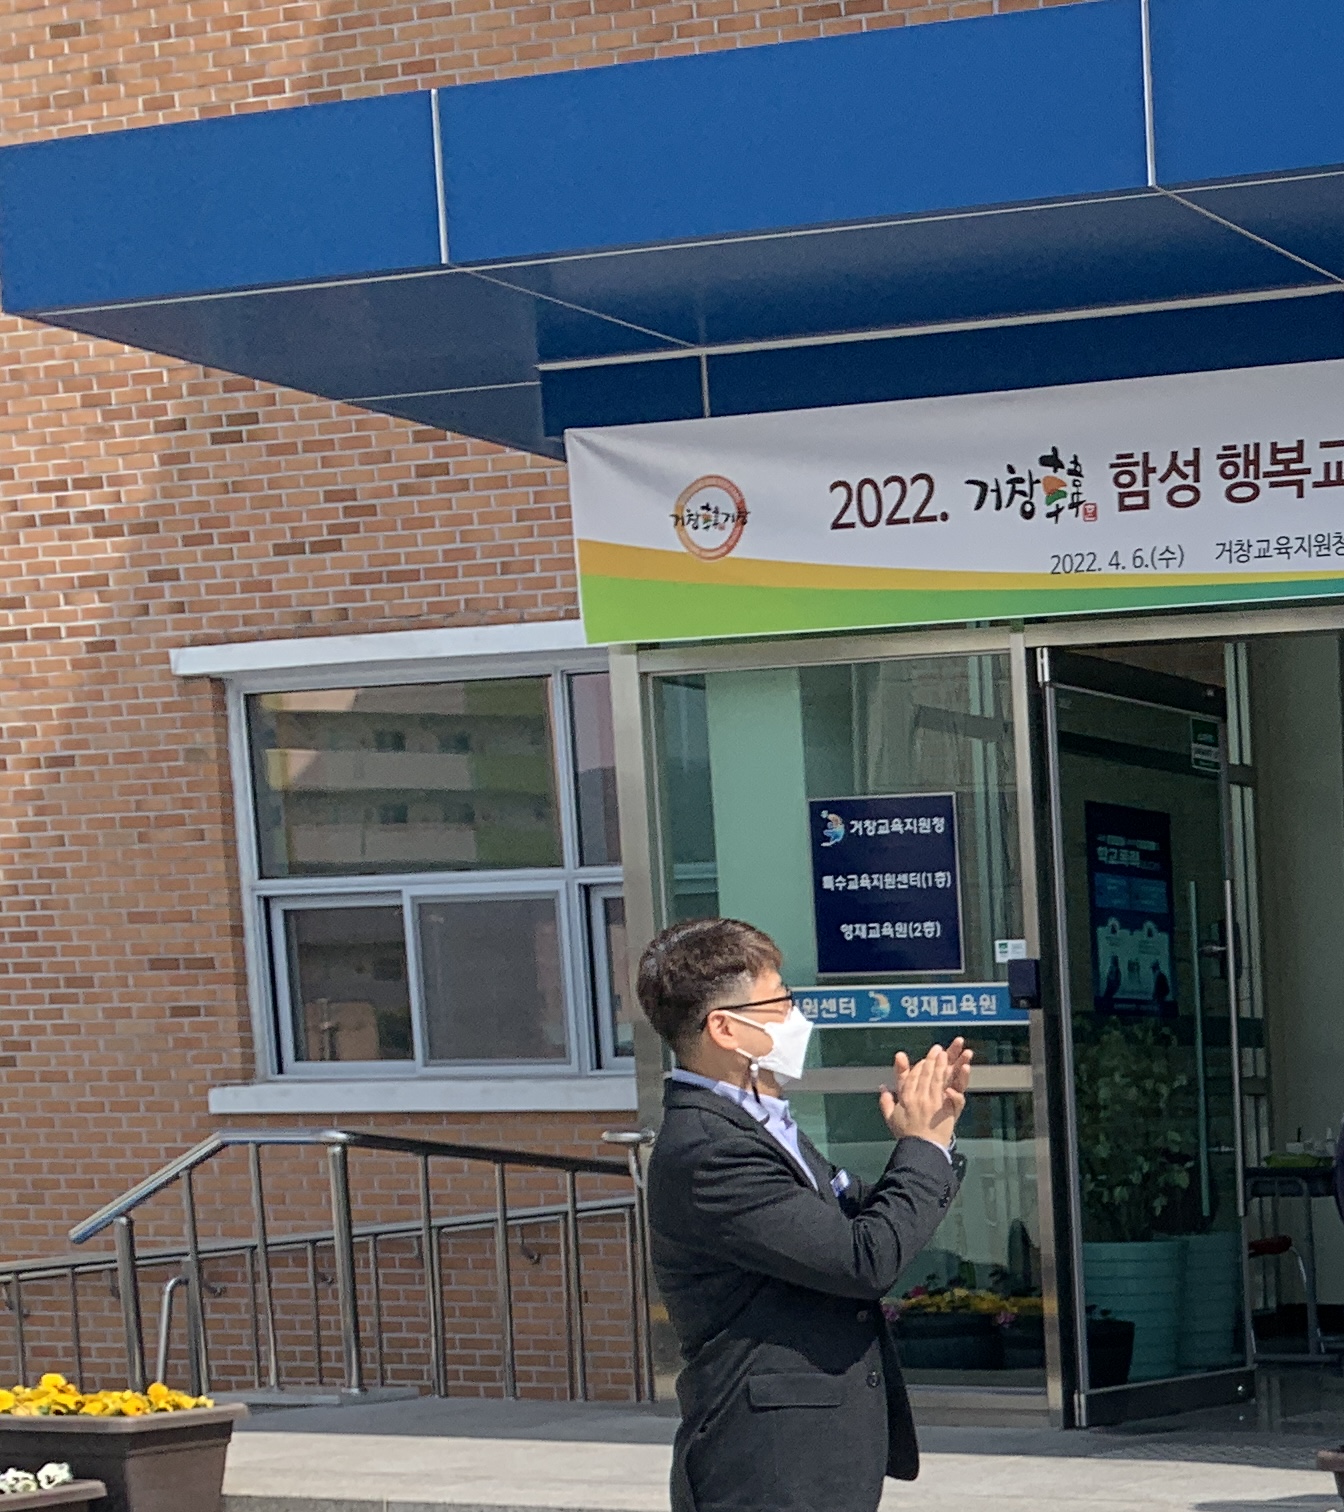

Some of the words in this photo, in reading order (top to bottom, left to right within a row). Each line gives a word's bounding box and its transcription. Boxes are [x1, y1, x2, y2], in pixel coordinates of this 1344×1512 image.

[829, 472, 949, 531] 2022.
[1109, 447, 1201, 512] 함성
[1050, 552, 1102, 576] 2022.
[1108, 550, 1127, 570] 4.
[1132, 544, 1185, 570] 6.(수)
[849, 816, 945, 837] 거창교육지원청
[822, 871, 951, 891] 특수교육지원센터(1층)
[840, 920, 941, 941] 영재교육원(2층)
[901, 993, 997, 1018] 영재교육원
